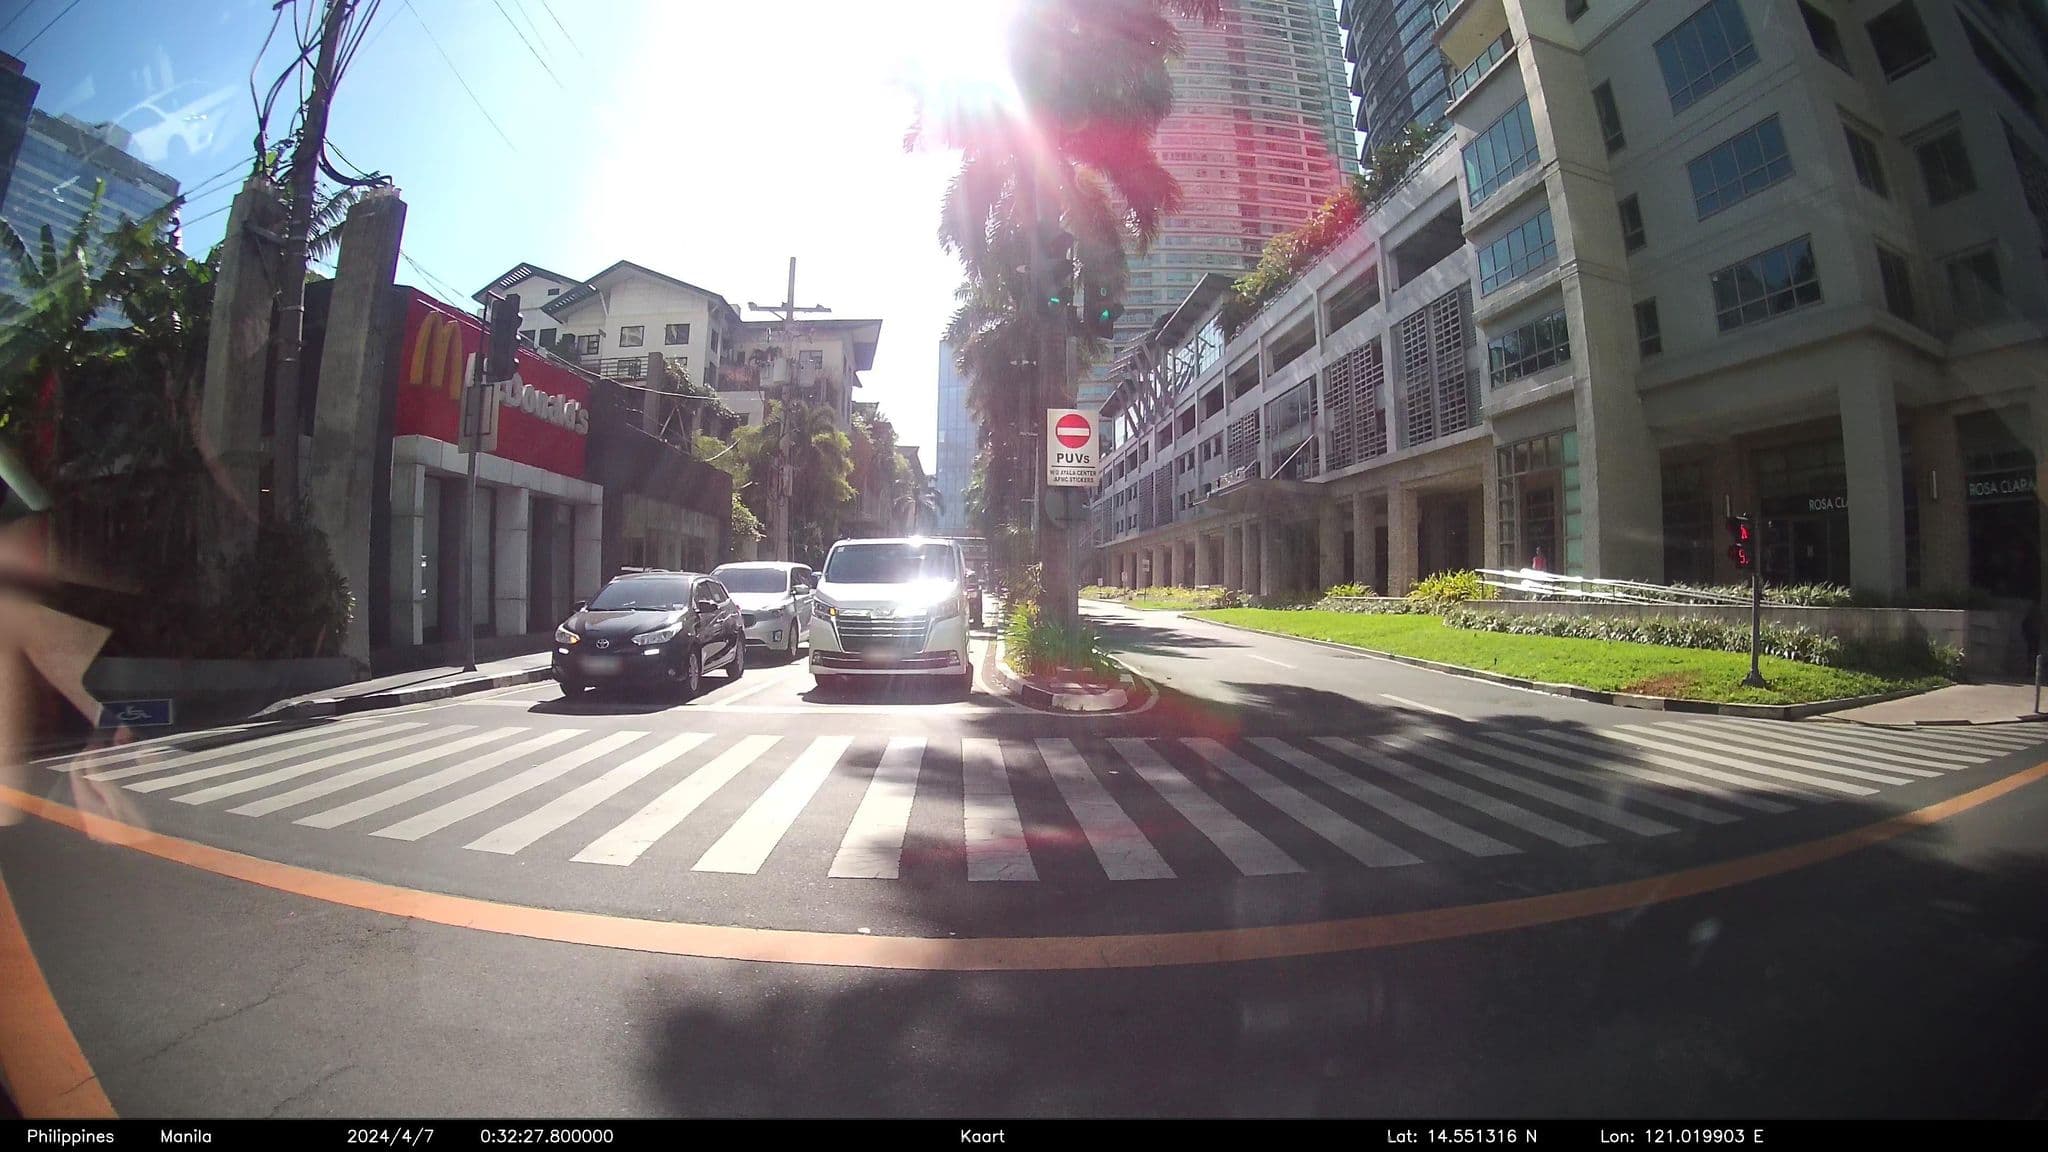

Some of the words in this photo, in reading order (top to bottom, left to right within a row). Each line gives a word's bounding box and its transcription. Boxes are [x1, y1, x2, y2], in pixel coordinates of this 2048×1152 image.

[1056, 453, 1090, 464] PUVs
[1967, 482, 1998, 497] ROSA
[1808, 498, 1834, 512] ROSA
[1834, 496, 1848, 509] CL
